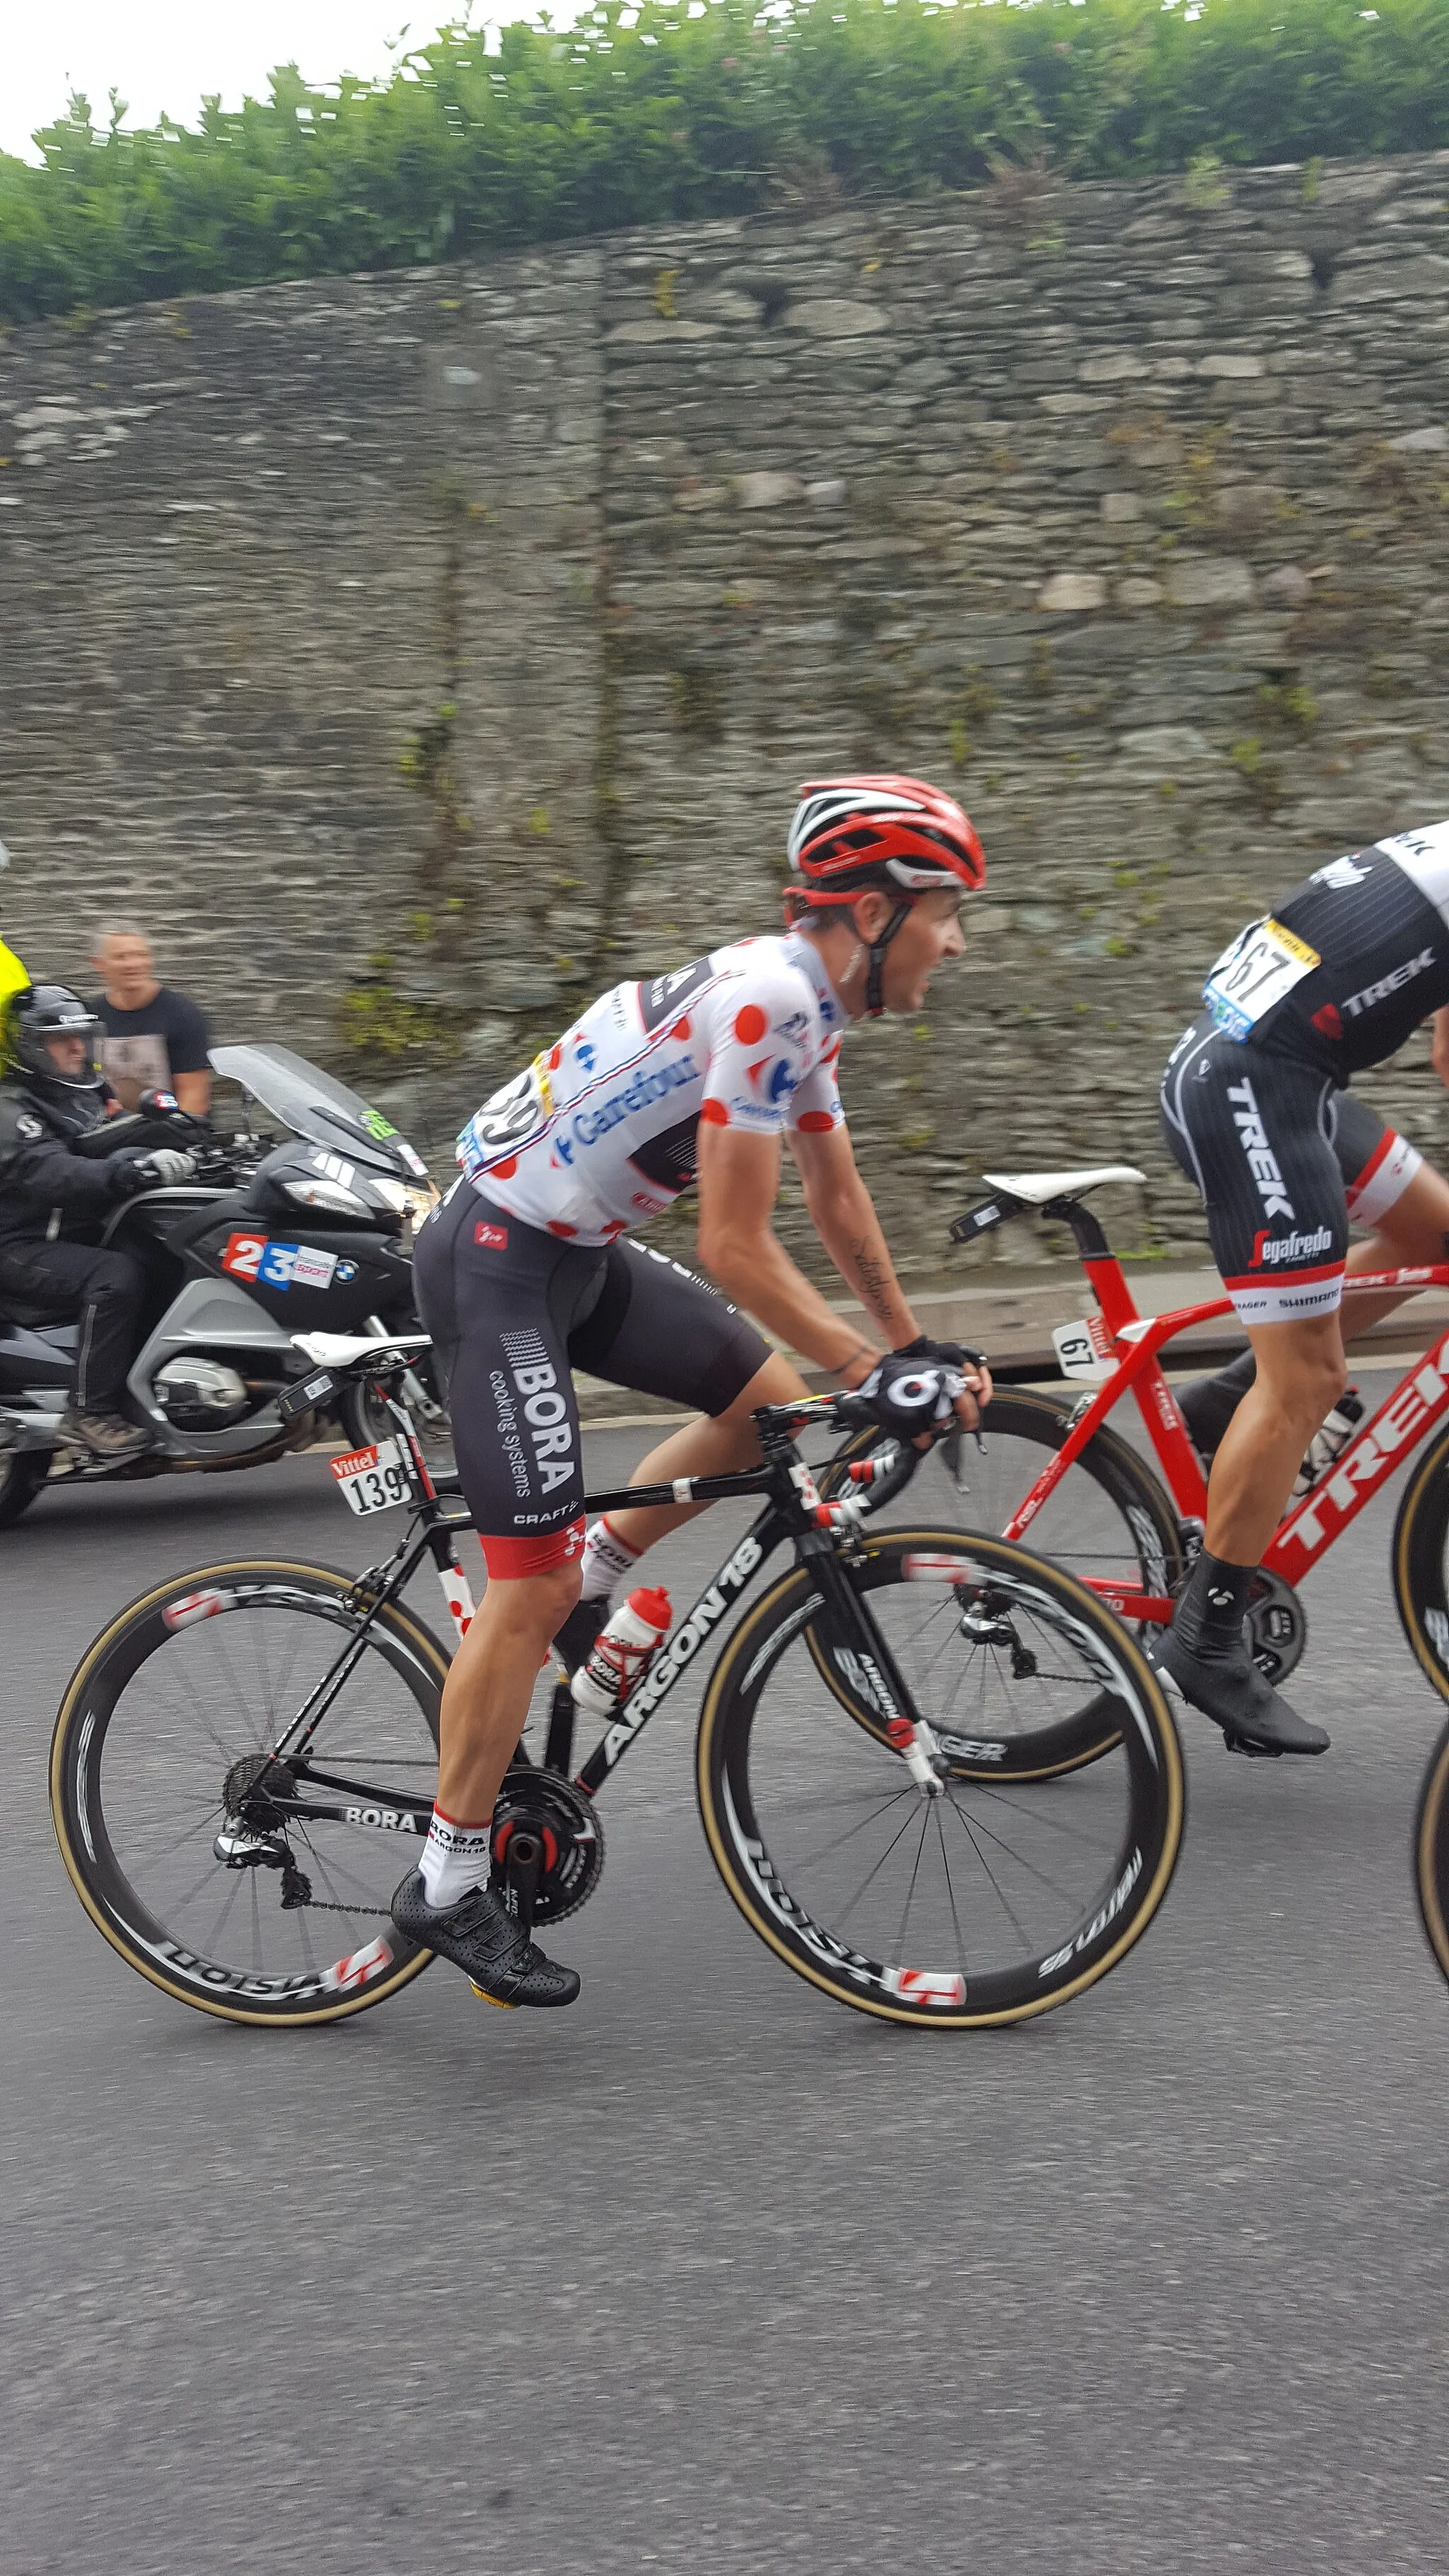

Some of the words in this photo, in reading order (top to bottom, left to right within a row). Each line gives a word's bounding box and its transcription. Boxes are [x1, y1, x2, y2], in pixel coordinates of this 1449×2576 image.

[1225, 942, 1291, 1003] 67
[1341, 947, 1437, 1017] TREK
[478, 1074, 538, 1145] 39
[571, 1054, 700, 1146] Carrefour
[1226, 1076, 1295, 1221] TREK
[1247, 1225, 1332, 1267] Segafredo
[1061, 1338, 1095, 1368] 67
[489, 1370, 517, 1433] cooking
[505, 1434, 531, 1498] systems
[513, 1363, 575, 1494] BORA
[331, 1452, 375, 1476] Vittel
[350, 1462, 405, 1513] 139
[514, 1503, 568, 1525] CRAFT
[604, 1586, 728, 1765] ARGON
[345, 1807, 417, 1832] BORA
[435, 1839, 472, 1854] ARGON
